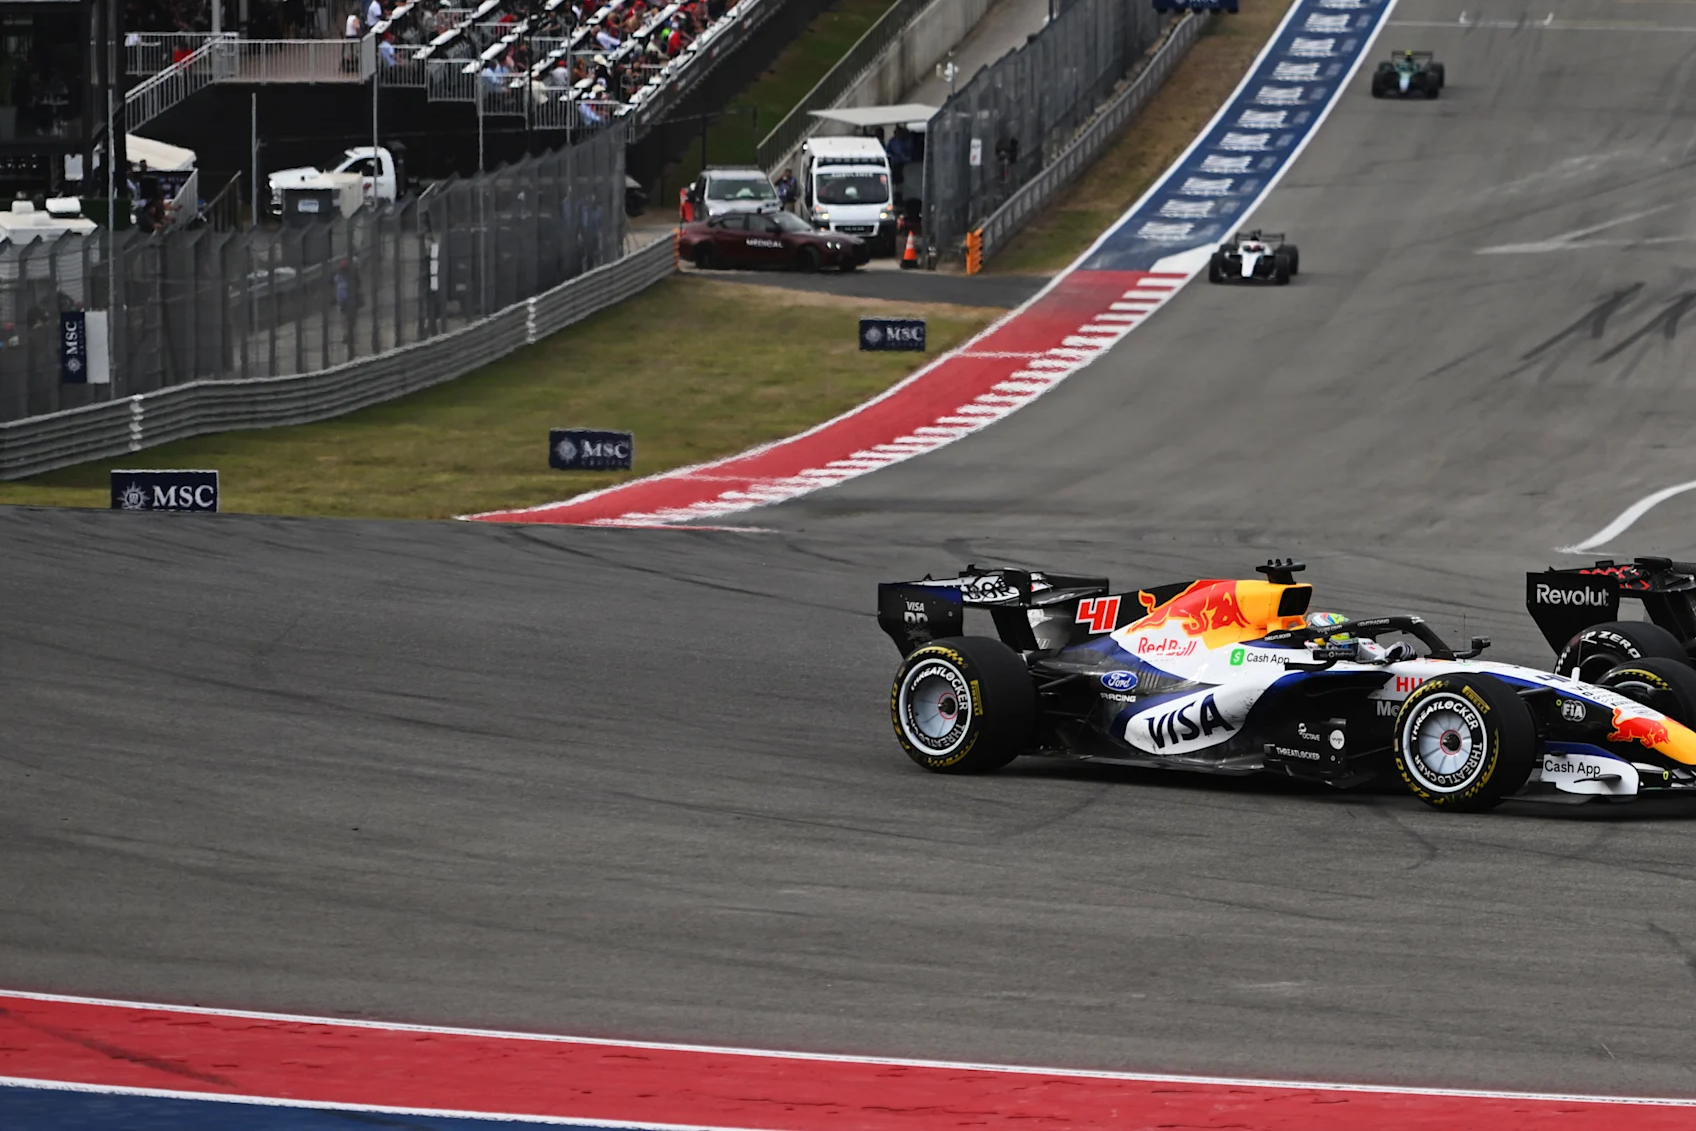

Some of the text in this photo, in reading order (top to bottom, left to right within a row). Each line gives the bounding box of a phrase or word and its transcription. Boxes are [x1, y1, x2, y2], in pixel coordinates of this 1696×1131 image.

[746, 238, 783, 249] MEDICAL
[65, 321, 78, 355] MSC
[887, 326, 923, 342] MSC
[581, 441, 629, 459] MSC
[152, 485, 214, 507] MSC
[1536, 583, 1609, 607] Revolut
[906, 601, 925, 612] VISA
[1075, 595, 1122, 634] 41
[1138, 637, 1197, 657] Red Bull
[1598, 630, 1642, 659] ZERO
[1247, 653, 1290, 666] Cash App
[1108, 673, 1132, 689] Ford
[970, 679, 983, 717] PIRELLI
[1462, 685, 1491, 715] PIRELLI
[1144, 693, 1235, 749] VISA
[1411, 700, 1479, 742] THREATLOCKER
[1563, 704, 1583, 718] FIA
[1302, 733, 1320, 741] OCTAVE
[1276, 746, 1320, 760] THREATLOCKER
[1414, 742, 1483, 785] THREATLOCKER
[1544, 759, 1601, 777] Cash App
